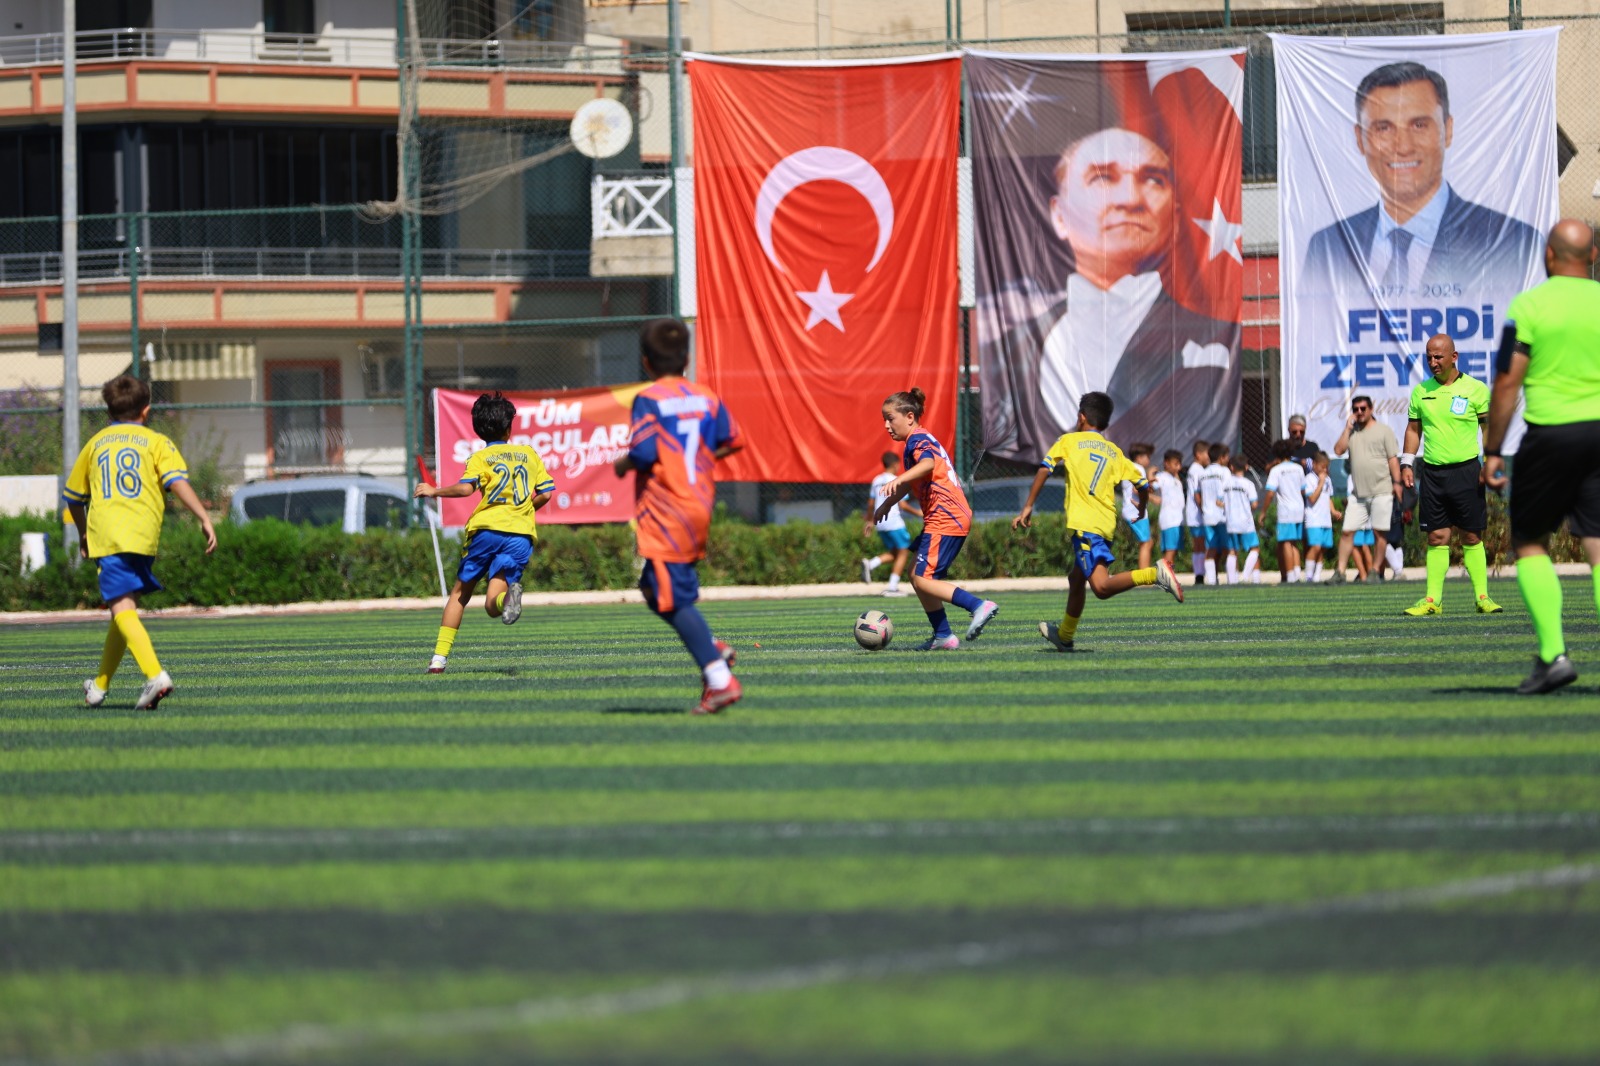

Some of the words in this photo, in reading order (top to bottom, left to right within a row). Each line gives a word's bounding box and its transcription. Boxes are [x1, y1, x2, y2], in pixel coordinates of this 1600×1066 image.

[1422, 282, 1462, 298] 2025
[516, 398, 583, 429] TÜM
[97, 447, 142, 499] 18
[676, 418, 701, 486] 7
[487, 463, 530, 506] 20
[1089, 452, 1107, 496] 7
